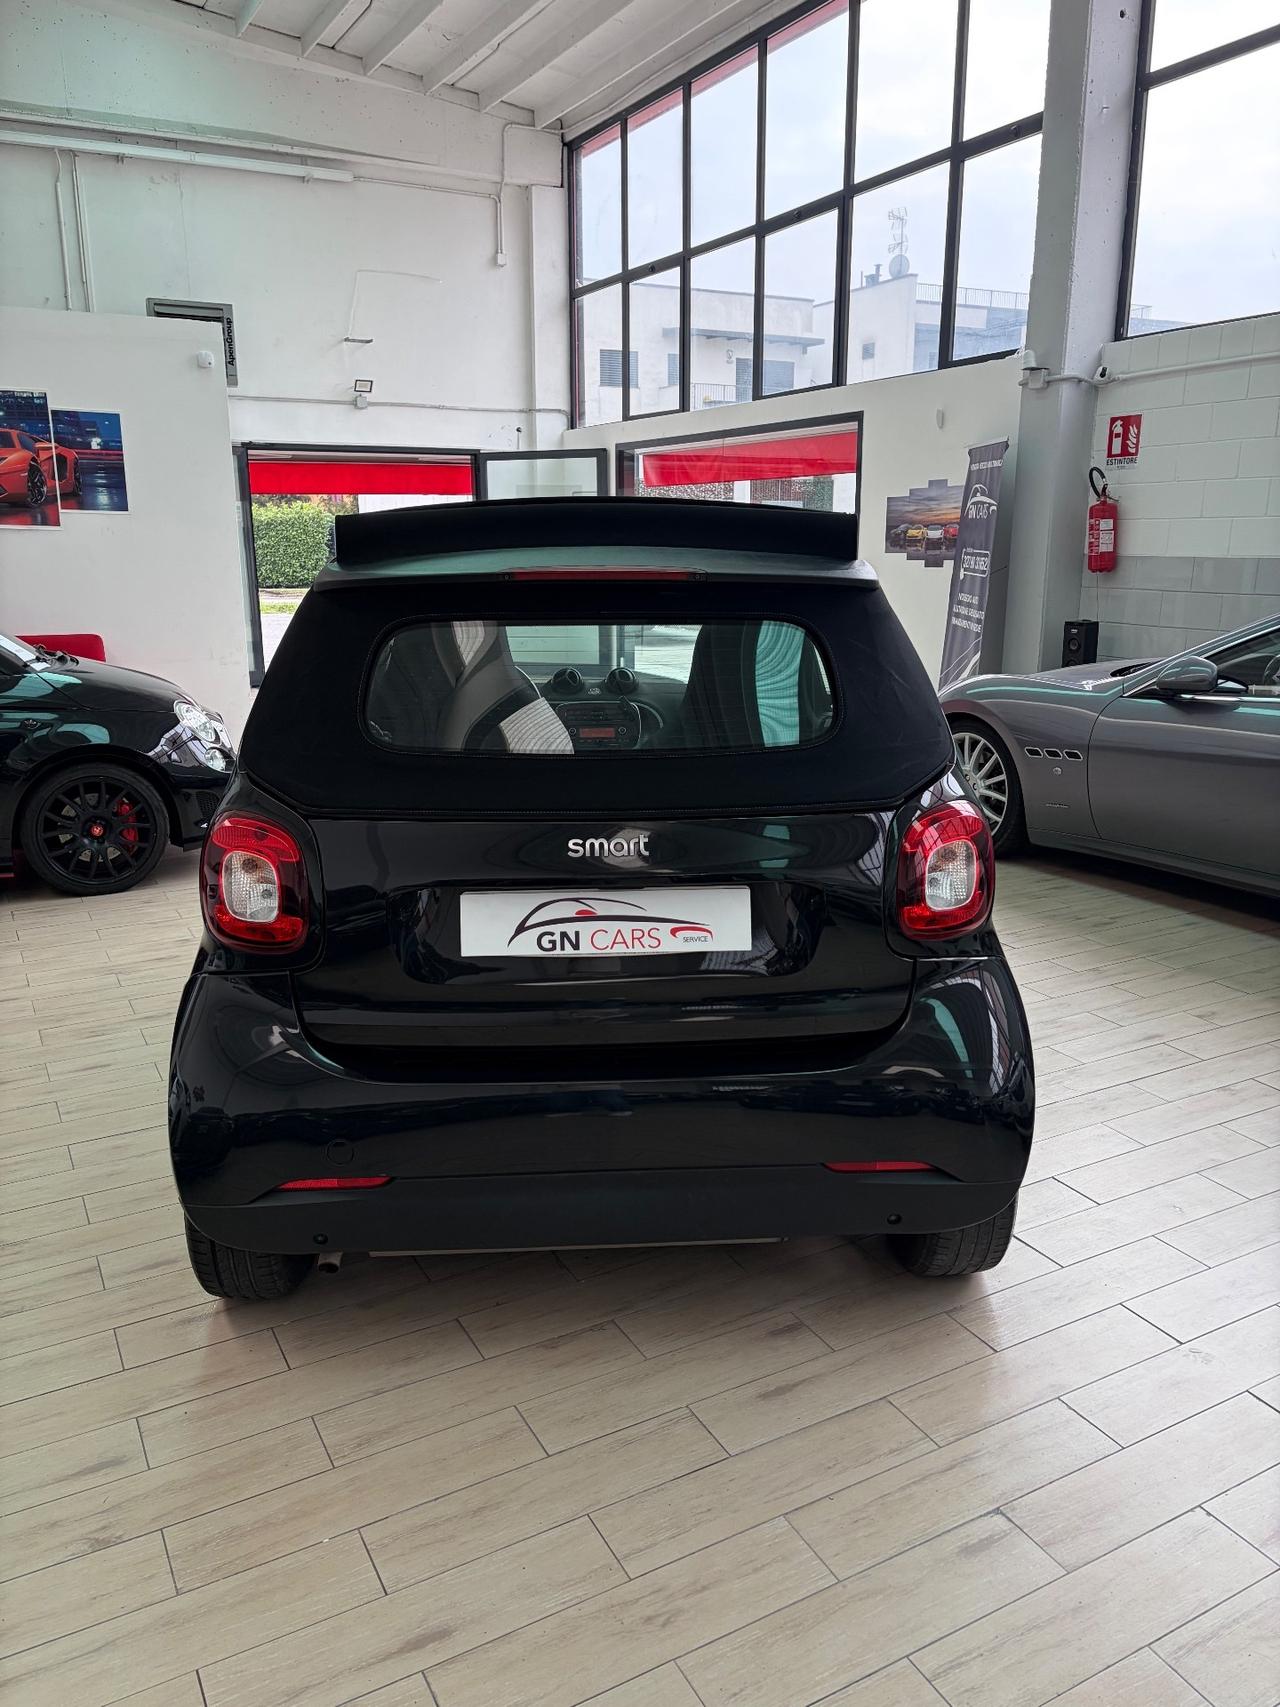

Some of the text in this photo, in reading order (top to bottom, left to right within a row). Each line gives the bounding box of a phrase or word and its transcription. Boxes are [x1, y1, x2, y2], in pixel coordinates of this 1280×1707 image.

[226, 317, 236, 367] ApenGroup
[1106, 457, 1138, 466] ESTINTORE
[567, 834, 650, 858] smart
[536, 927, 709, 952] GN CARS SERVICE
